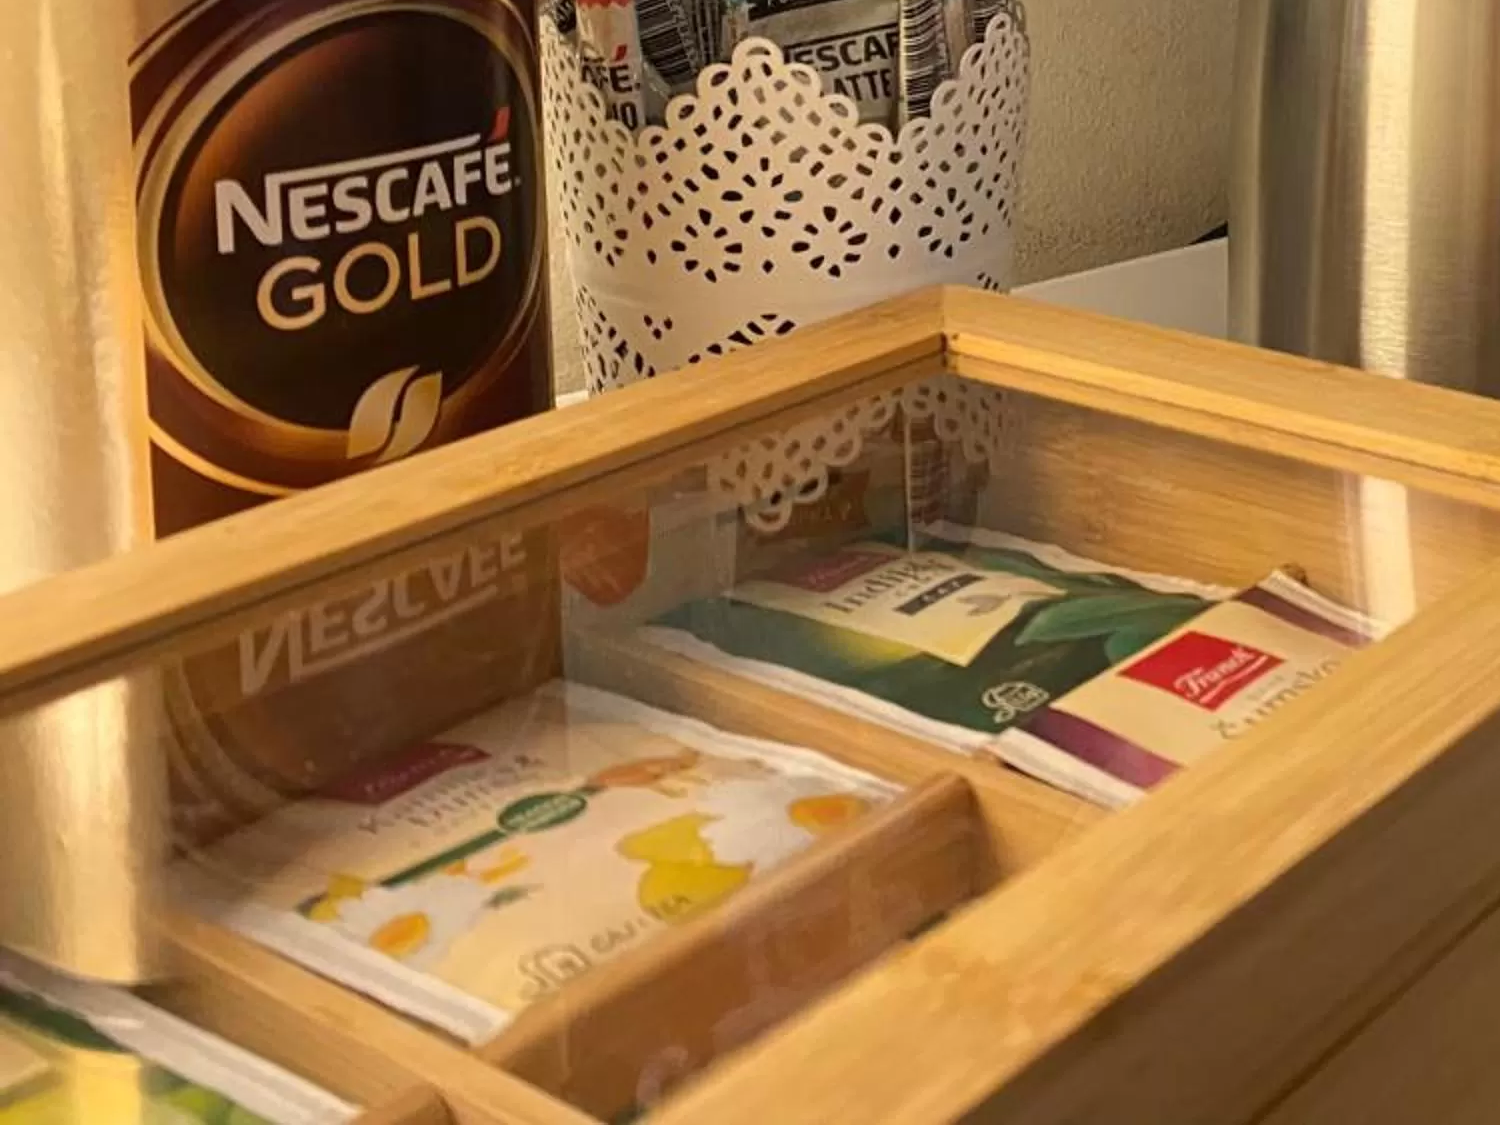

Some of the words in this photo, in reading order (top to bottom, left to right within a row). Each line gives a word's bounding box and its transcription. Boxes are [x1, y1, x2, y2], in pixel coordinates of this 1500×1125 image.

[820, 69, 893, 102] ATTE
[213, 106, 522, 255] NESCAFÉ
[256, 215, 502, 331] GOLD
